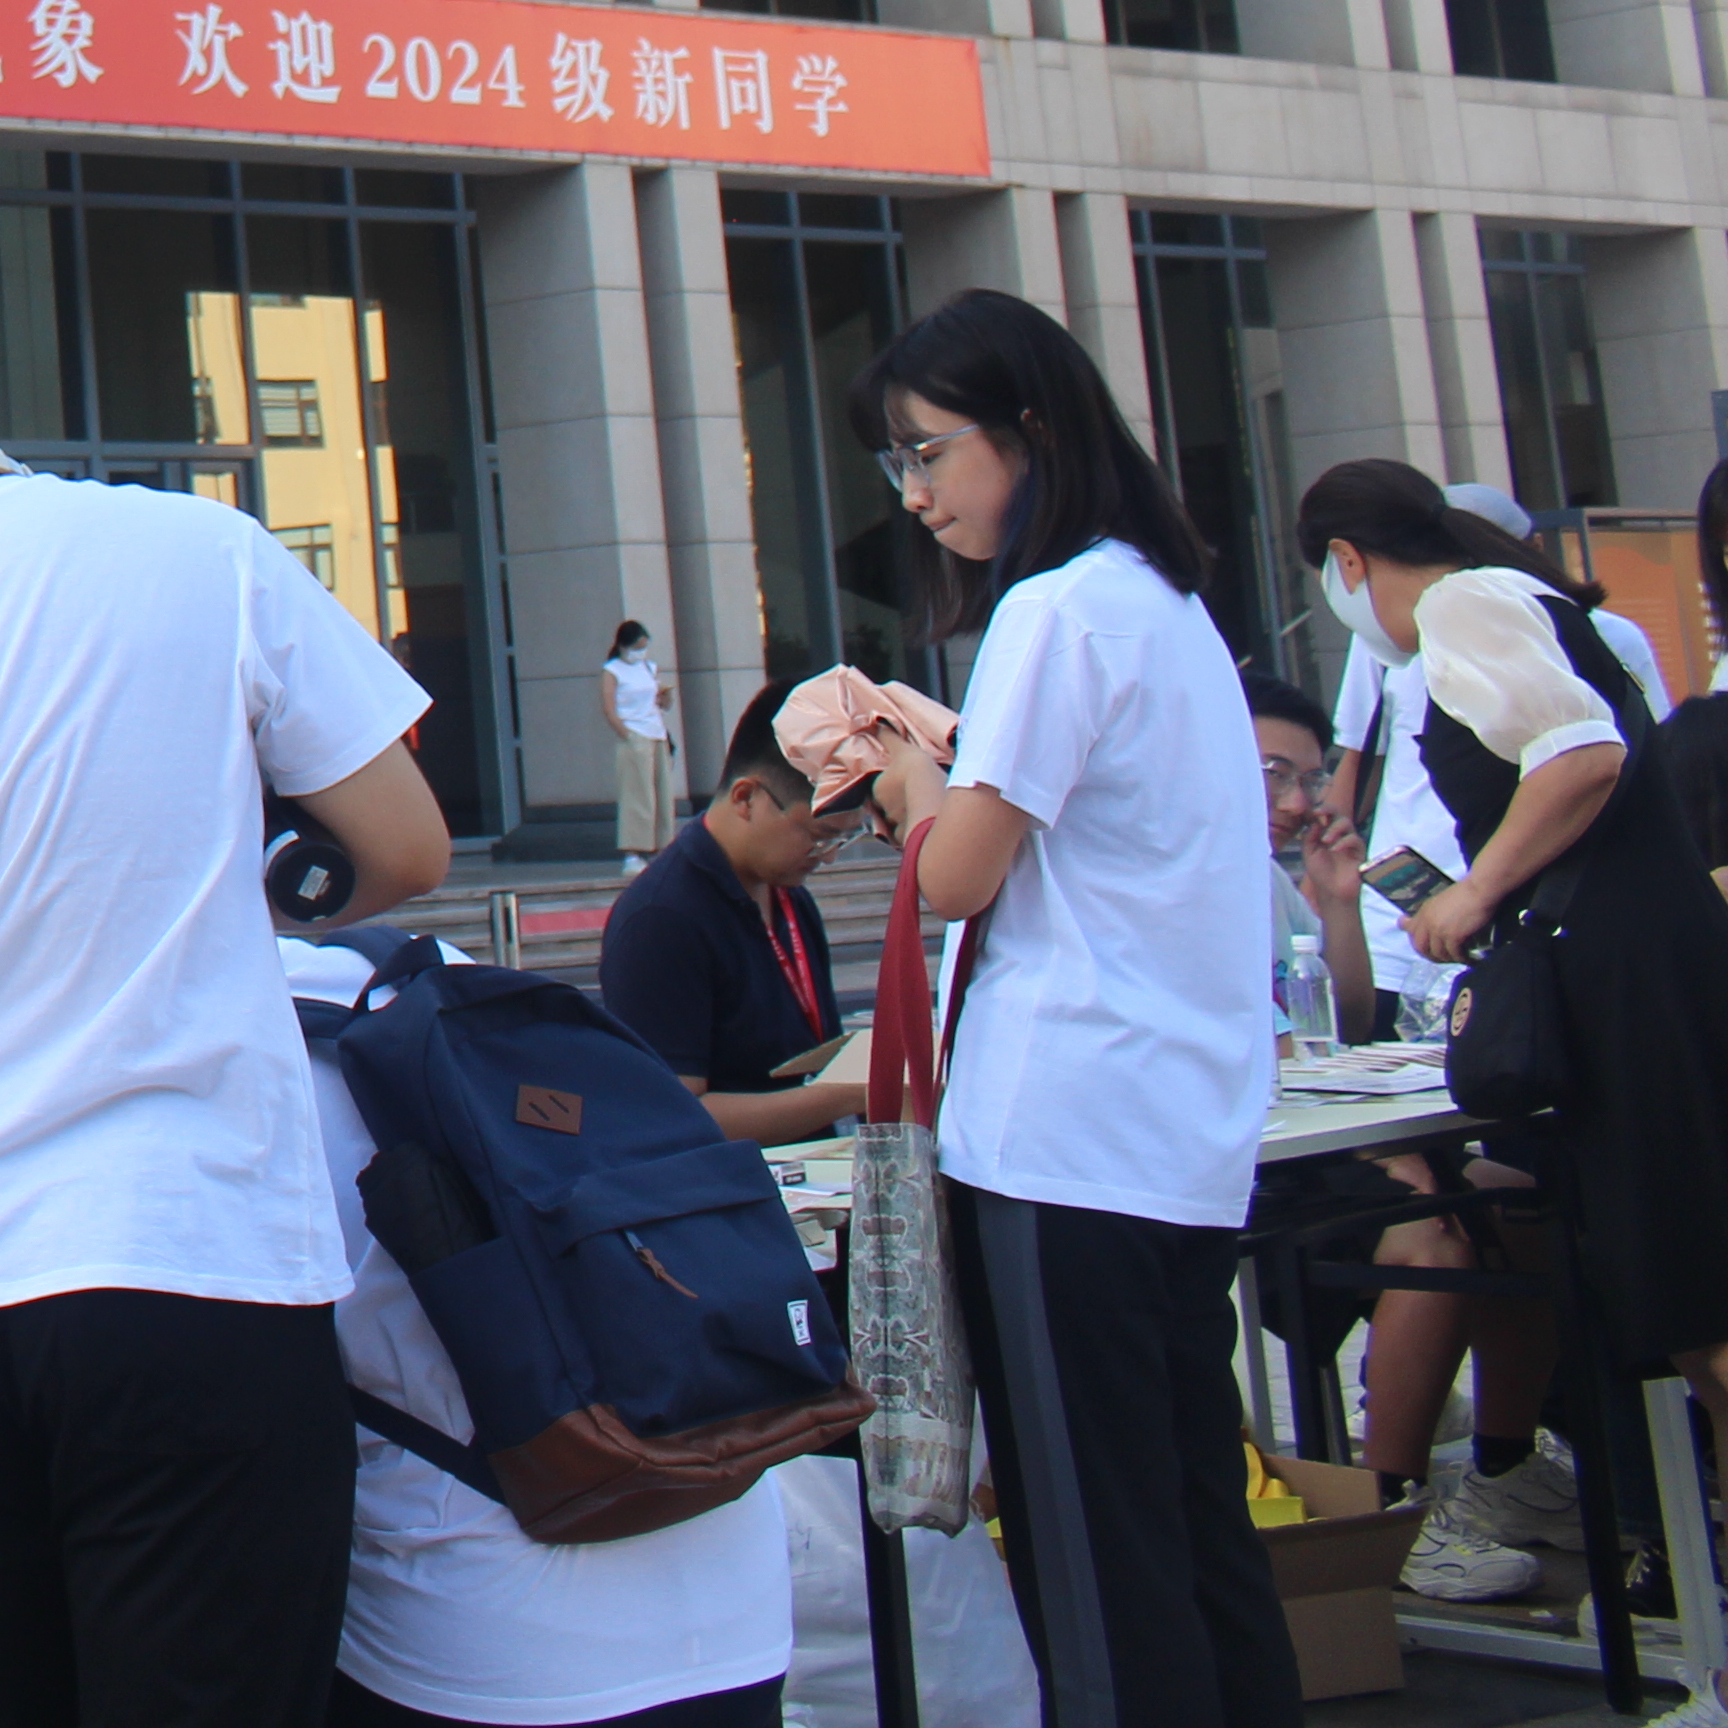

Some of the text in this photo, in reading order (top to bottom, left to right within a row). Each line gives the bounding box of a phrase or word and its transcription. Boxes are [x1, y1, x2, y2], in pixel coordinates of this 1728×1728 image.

[173, 2, 850, 138] 欢迎2024级新同学
